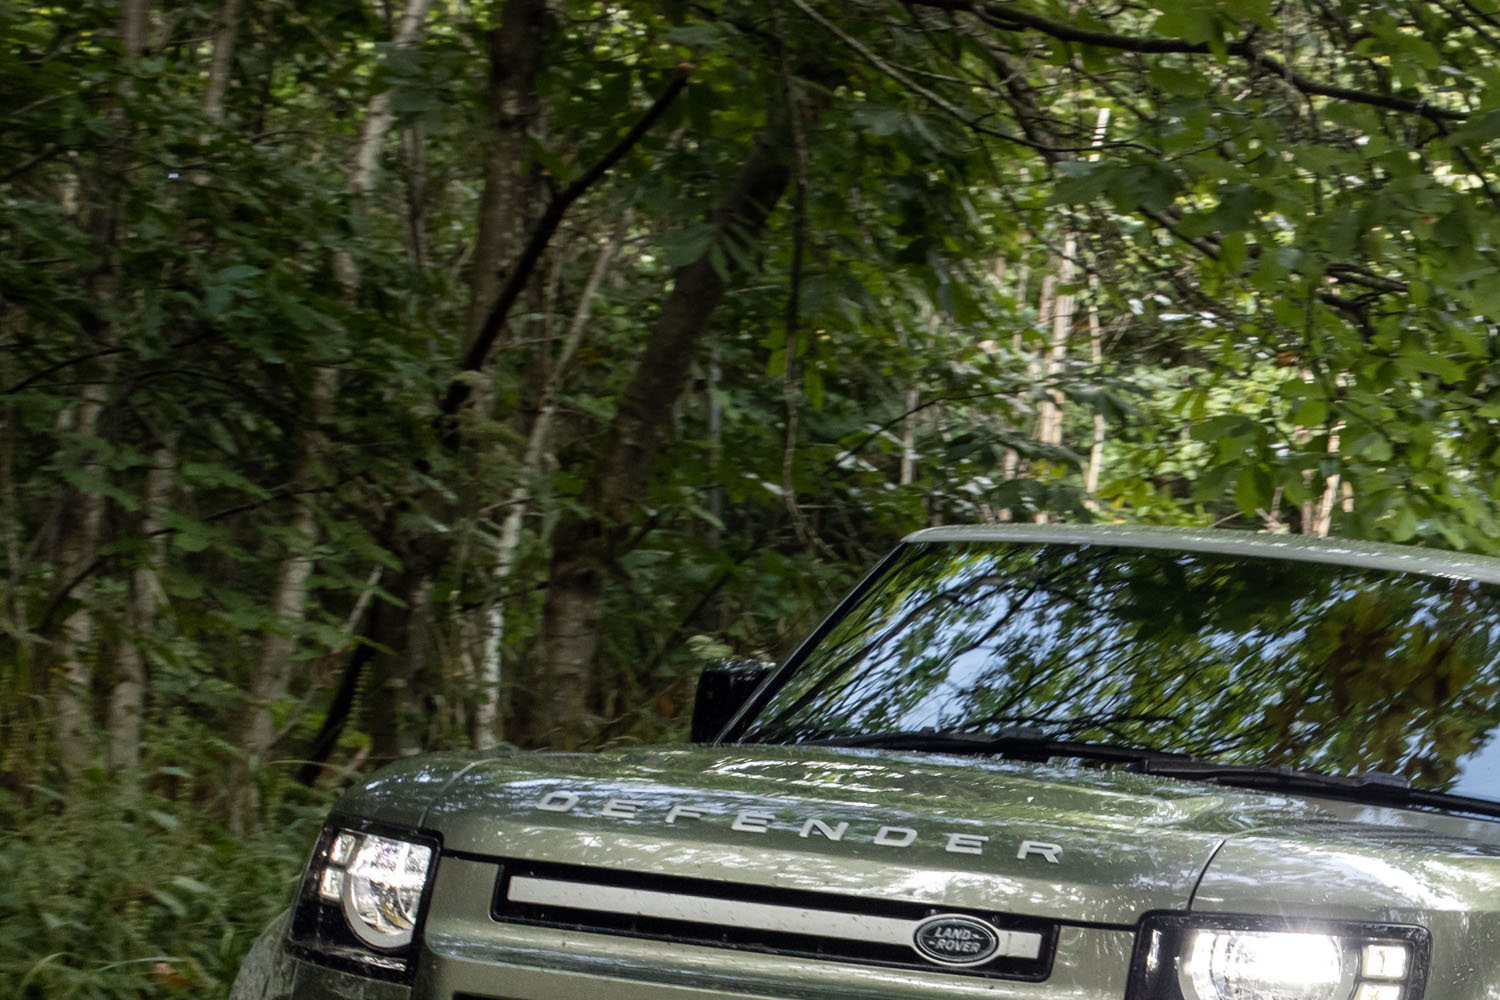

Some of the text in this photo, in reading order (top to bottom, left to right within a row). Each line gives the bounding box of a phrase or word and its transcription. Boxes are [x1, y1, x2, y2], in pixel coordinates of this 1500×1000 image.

[536, 791, 1064, 864] DEFENDER
[934, 927, 973, 940] LAND
[936, 939, 980, 953] ROVER
